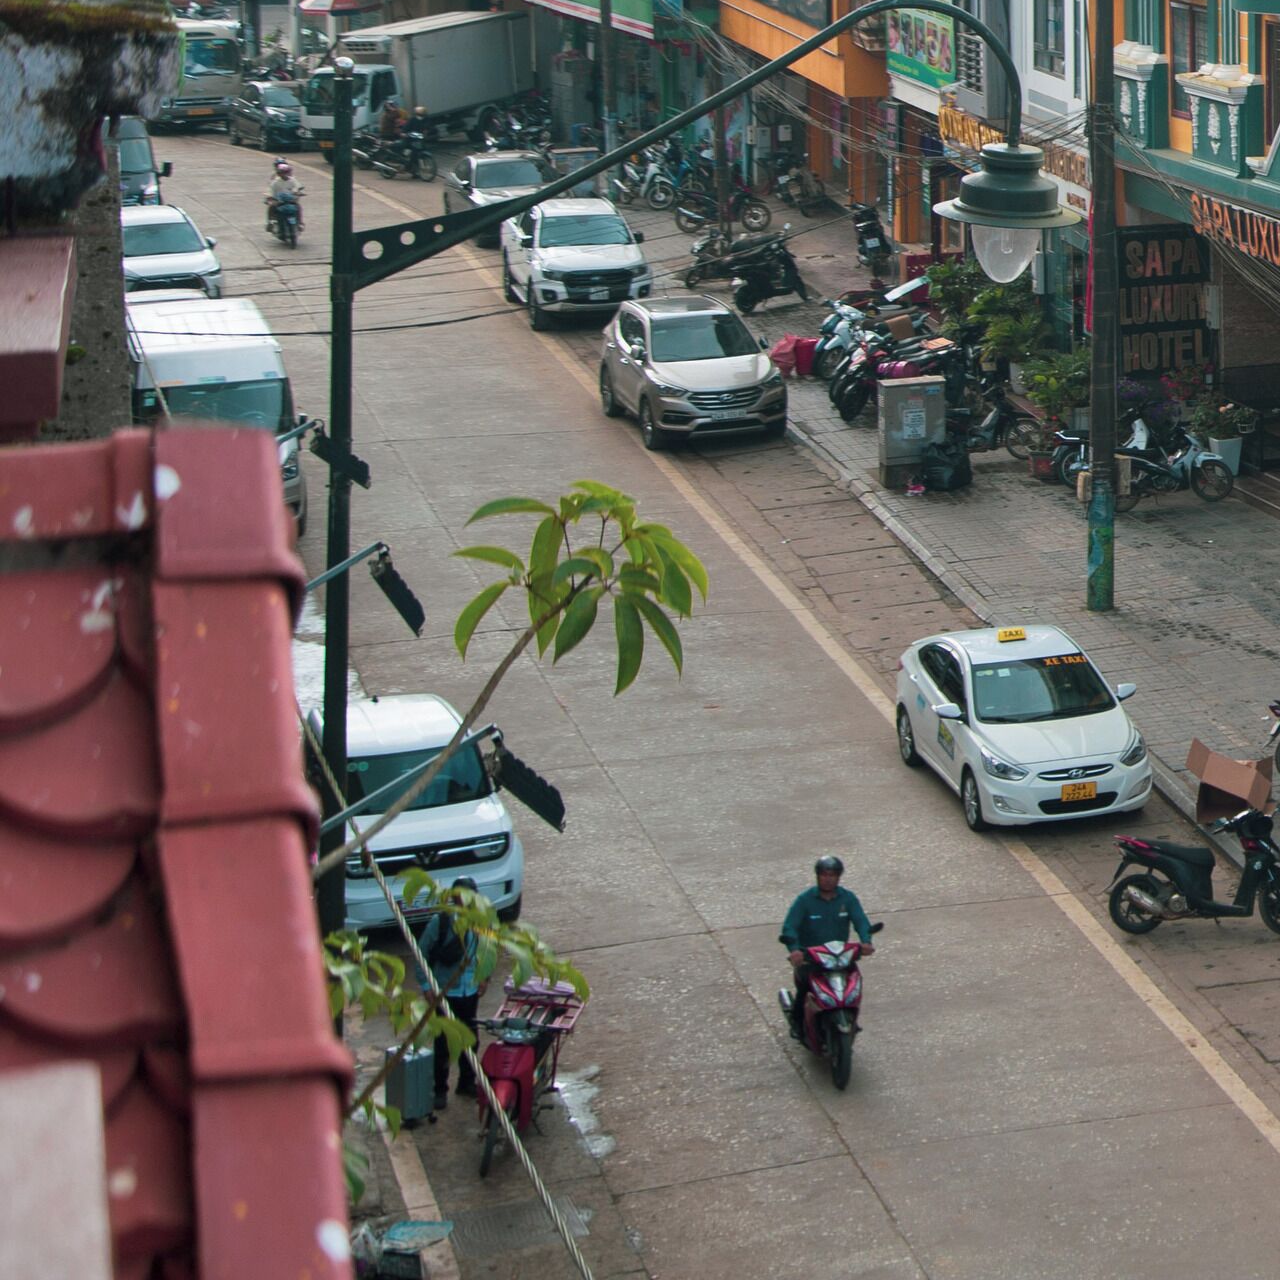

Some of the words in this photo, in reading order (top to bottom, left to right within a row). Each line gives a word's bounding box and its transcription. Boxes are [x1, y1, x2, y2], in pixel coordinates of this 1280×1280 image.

[1190, 192, 1234, 248] SAPA
[1126, 238, 1201, 279] SAPA
[1123, 328, 1208, 372] HOTEL
[1003, 629, 1024, 638] TAXI
[1044, 657, 1061, 666] XE
[1062, 655, 1088, 666] TAXI
